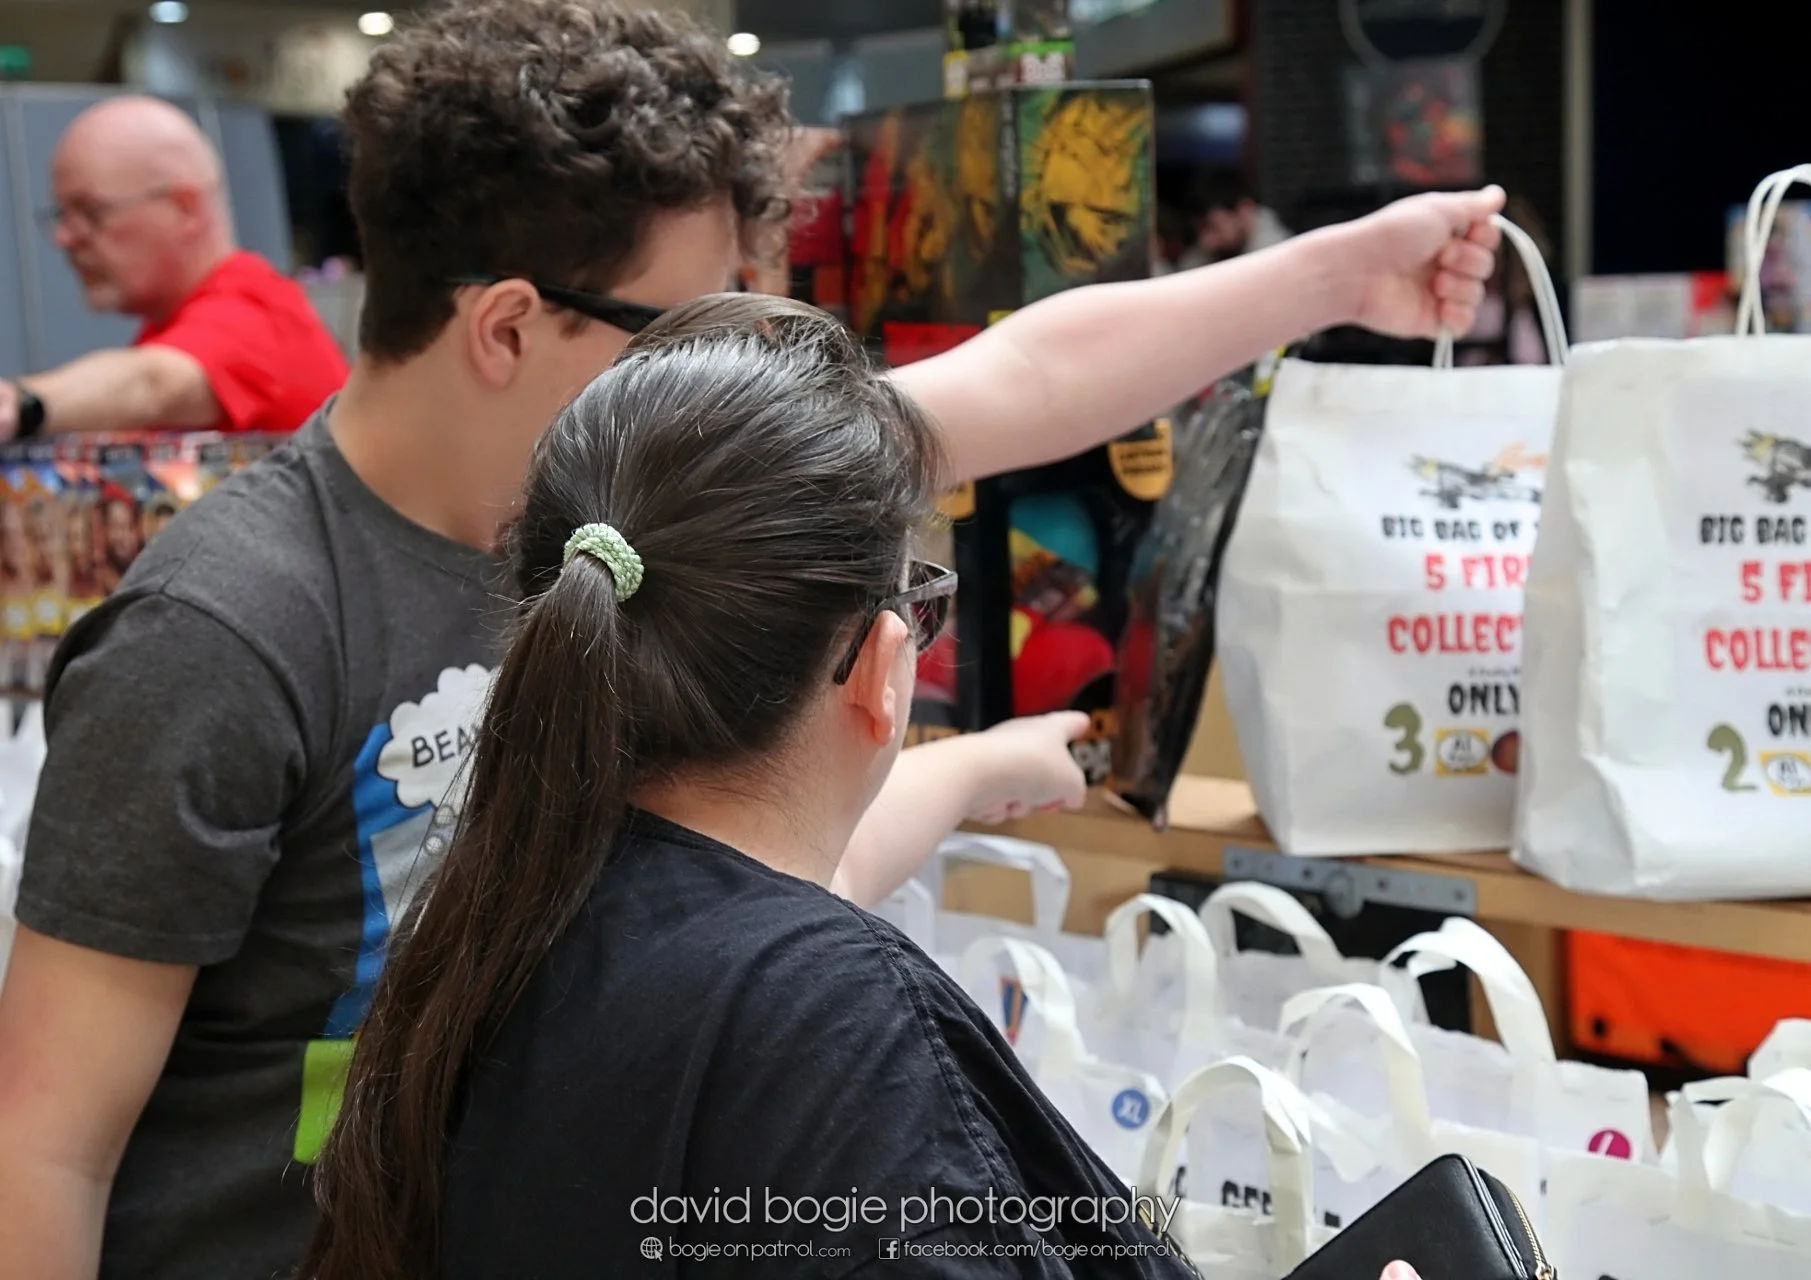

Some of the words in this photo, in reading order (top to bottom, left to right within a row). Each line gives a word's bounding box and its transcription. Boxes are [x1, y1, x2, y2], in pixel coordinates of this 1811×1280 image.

[1381, 516, 1424, 538] BIG
[1434, 519, 1482, 541] BAG
[1700, 515, 1744, 544] BIG
[1757, 516, 1806, 545] BAG
[1424, 553, 1446, 591] 5
[1460, 554, 1533, 589] FIR
[1741, 560, 1764, 604] 5
[1384, 702, 1425, 775] 3
[1706, 723, 1758, 791] 2
[1118, 1096, 1143, 1124] XL
